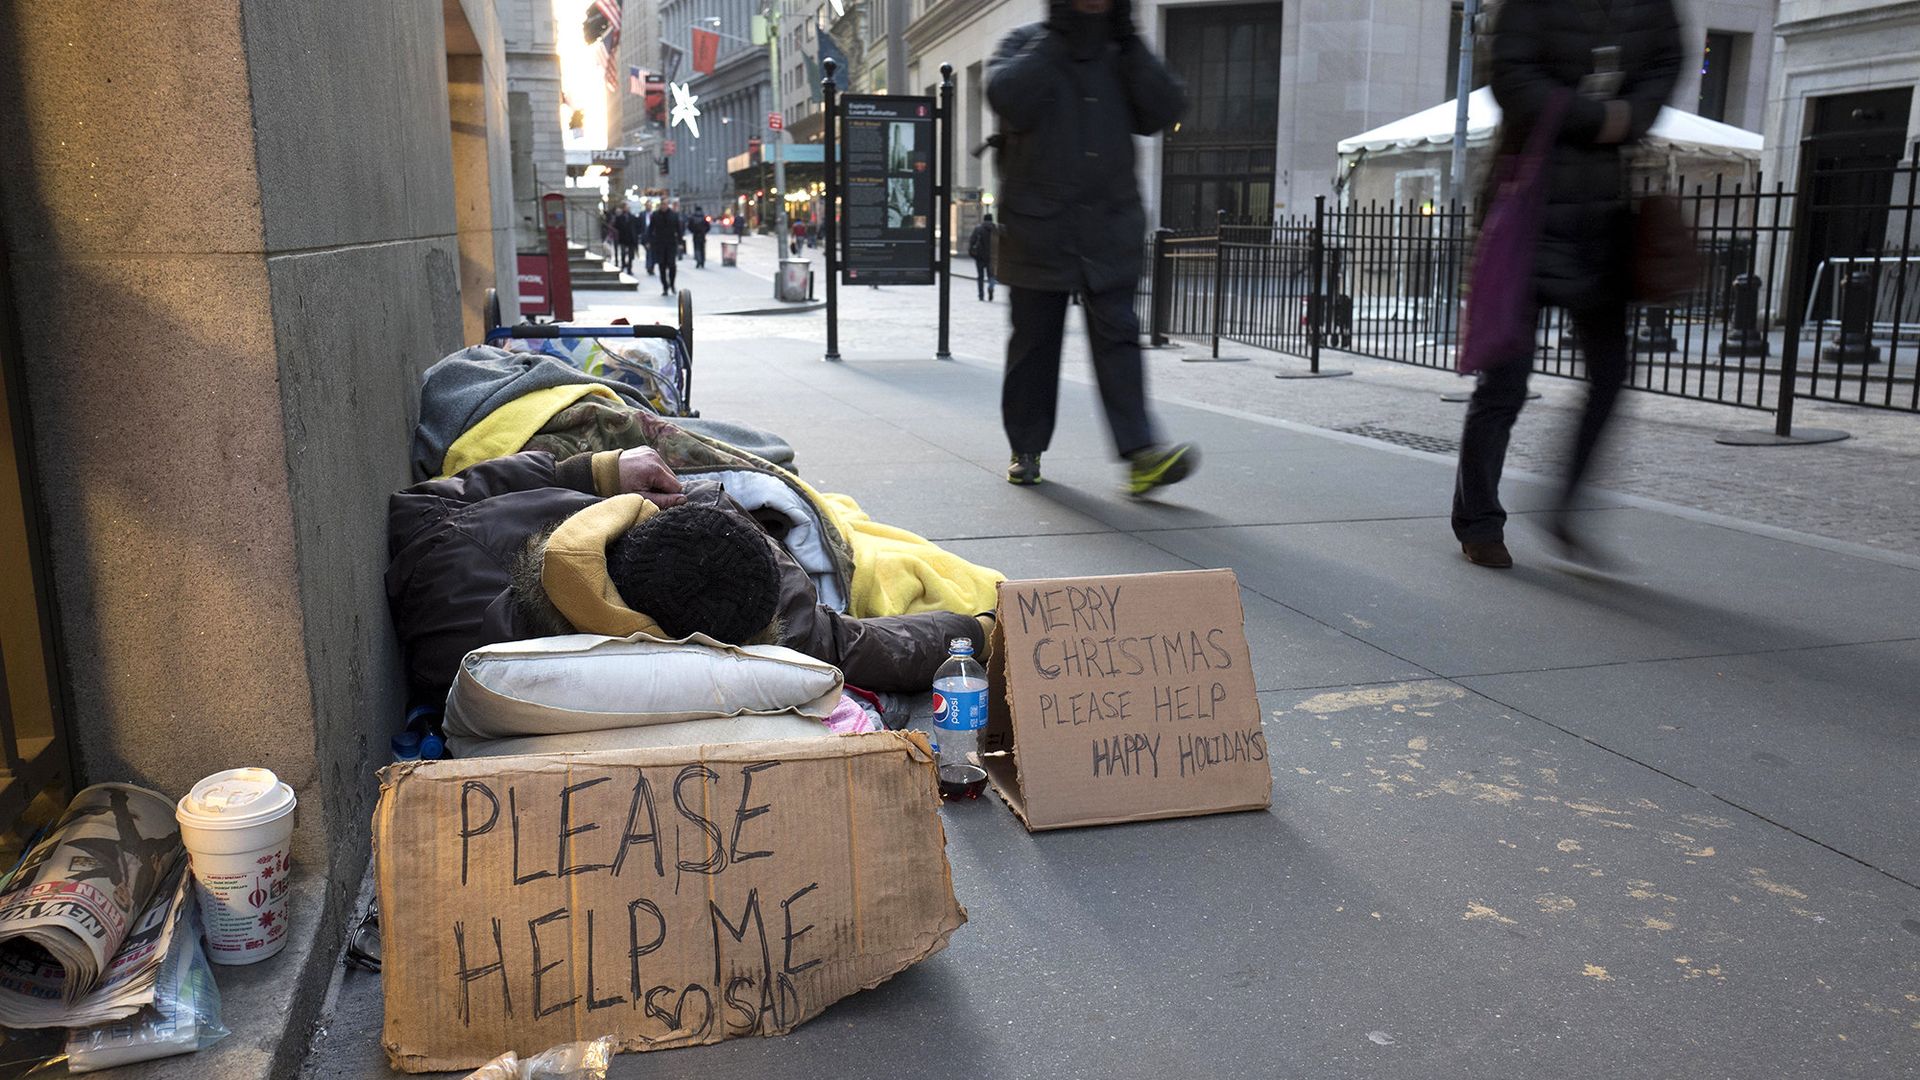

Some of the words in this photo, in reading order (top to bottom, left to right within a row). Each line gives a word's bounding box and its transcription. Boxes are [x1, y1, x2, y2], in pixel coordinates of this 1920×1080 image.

[1017, 585, 1121, 635] MERRY
[1033, 628, 1233, 680] CHRISTMAS
[950, 698, 960, 724] pepsi
[1039, 690, 1133, 728] PLEASE
[1154, 682, 1226, 722] HELP
[1092, 731, 1161, 778] HAPPY
[1178, 728, 1265, 778] HOLIDAYS
[458, 760, 782, 895] PLEASE
[39, 902, 106, 939] NEW
[454, 898, 667, 1028] HELP
[709, 882, 823, 986] ME
[724, 971, 801, 1038] SAD
